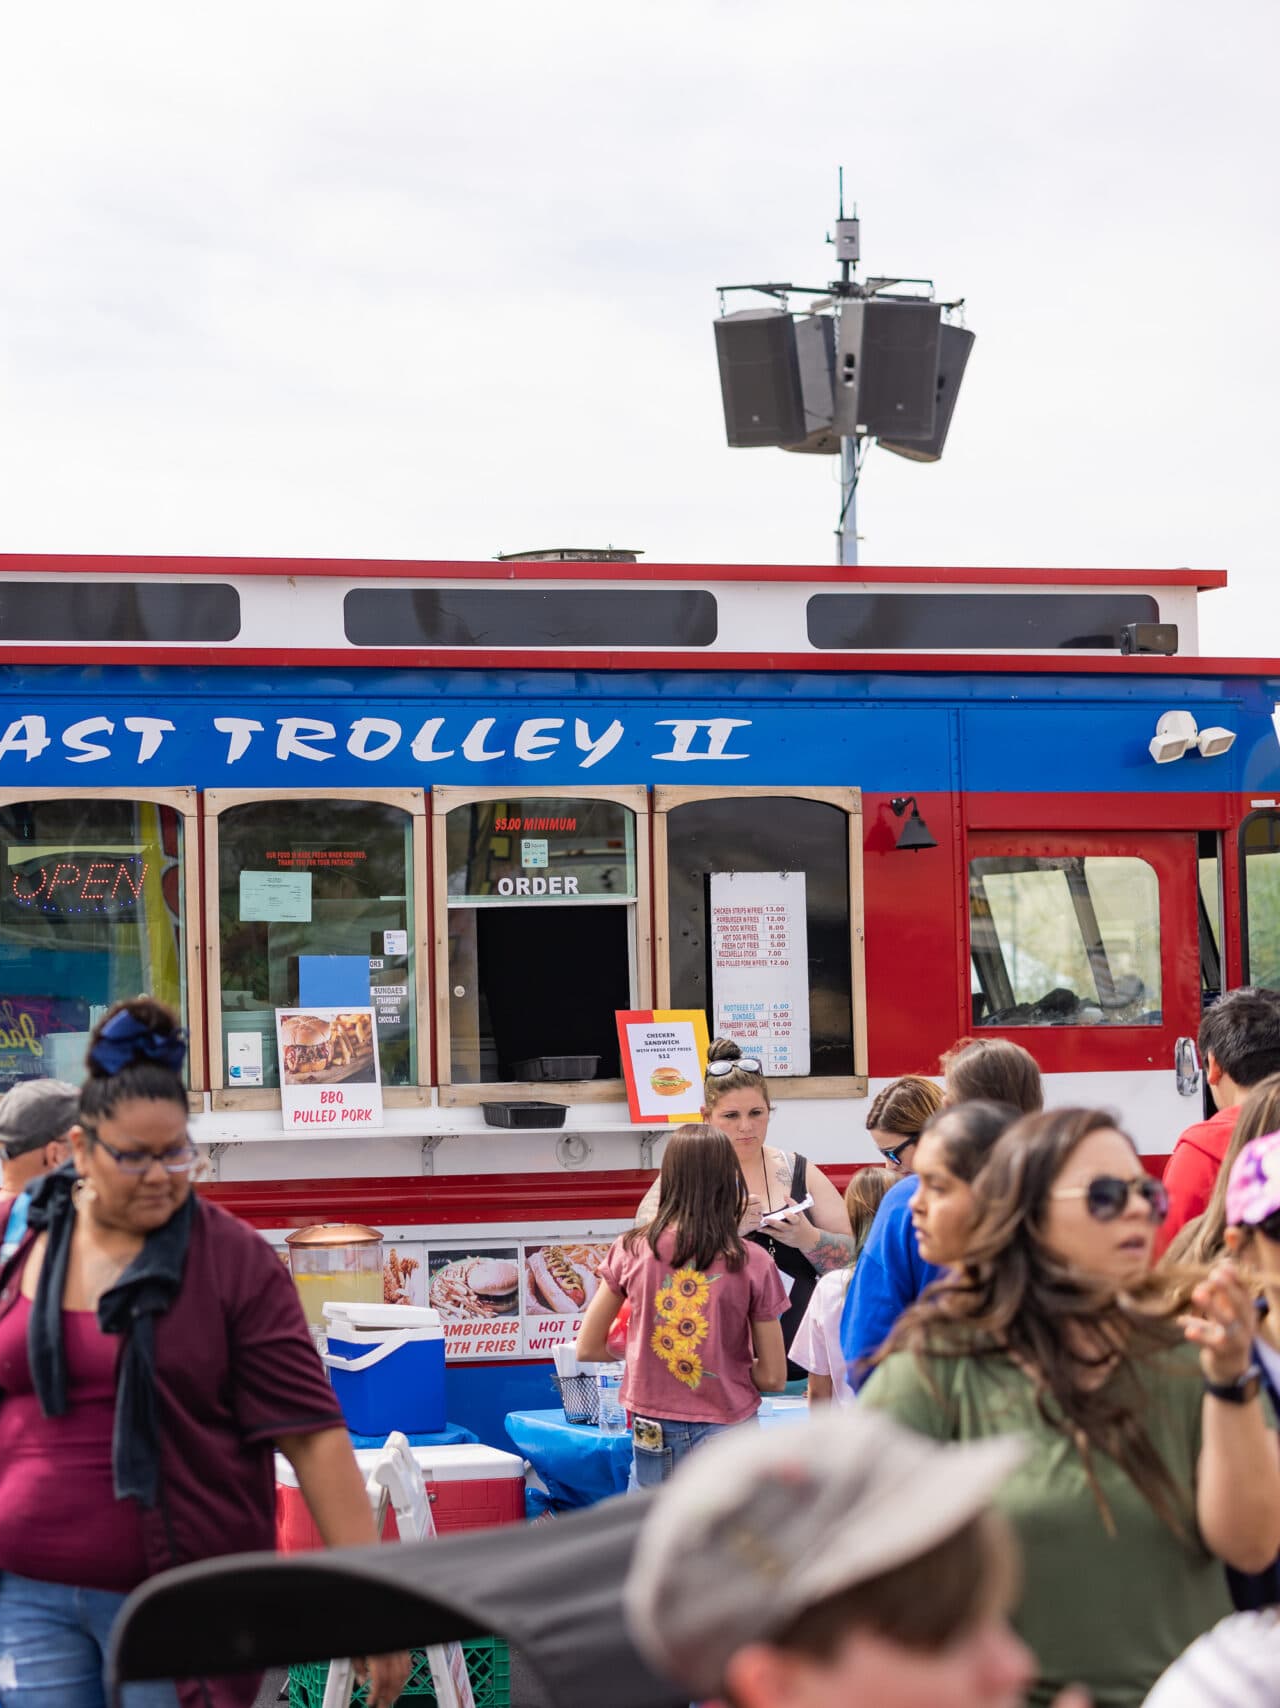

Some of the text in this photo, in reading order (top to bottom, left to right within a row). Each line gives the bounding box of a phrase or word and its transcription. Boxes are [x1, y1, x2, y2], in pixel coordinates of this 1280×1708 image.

[213, 717, 625, 768] TROLLEY
[651, 719, 753, 761] II
[495, 817, 577, 832] $5.00 MINIMUM
[12, 864, 150, 900] OPEN
[497, 876, 579, 896] ORDER
[320, 1091, 344, 1105] BBQ
[293, 1108, 372, 1124] PULLED PORK
[443, 1322, 520, 1337] AMBURGER
[538, 1320, 566, 1333] HOT
[445, 1340, 516, 1354] ITH FRIES
